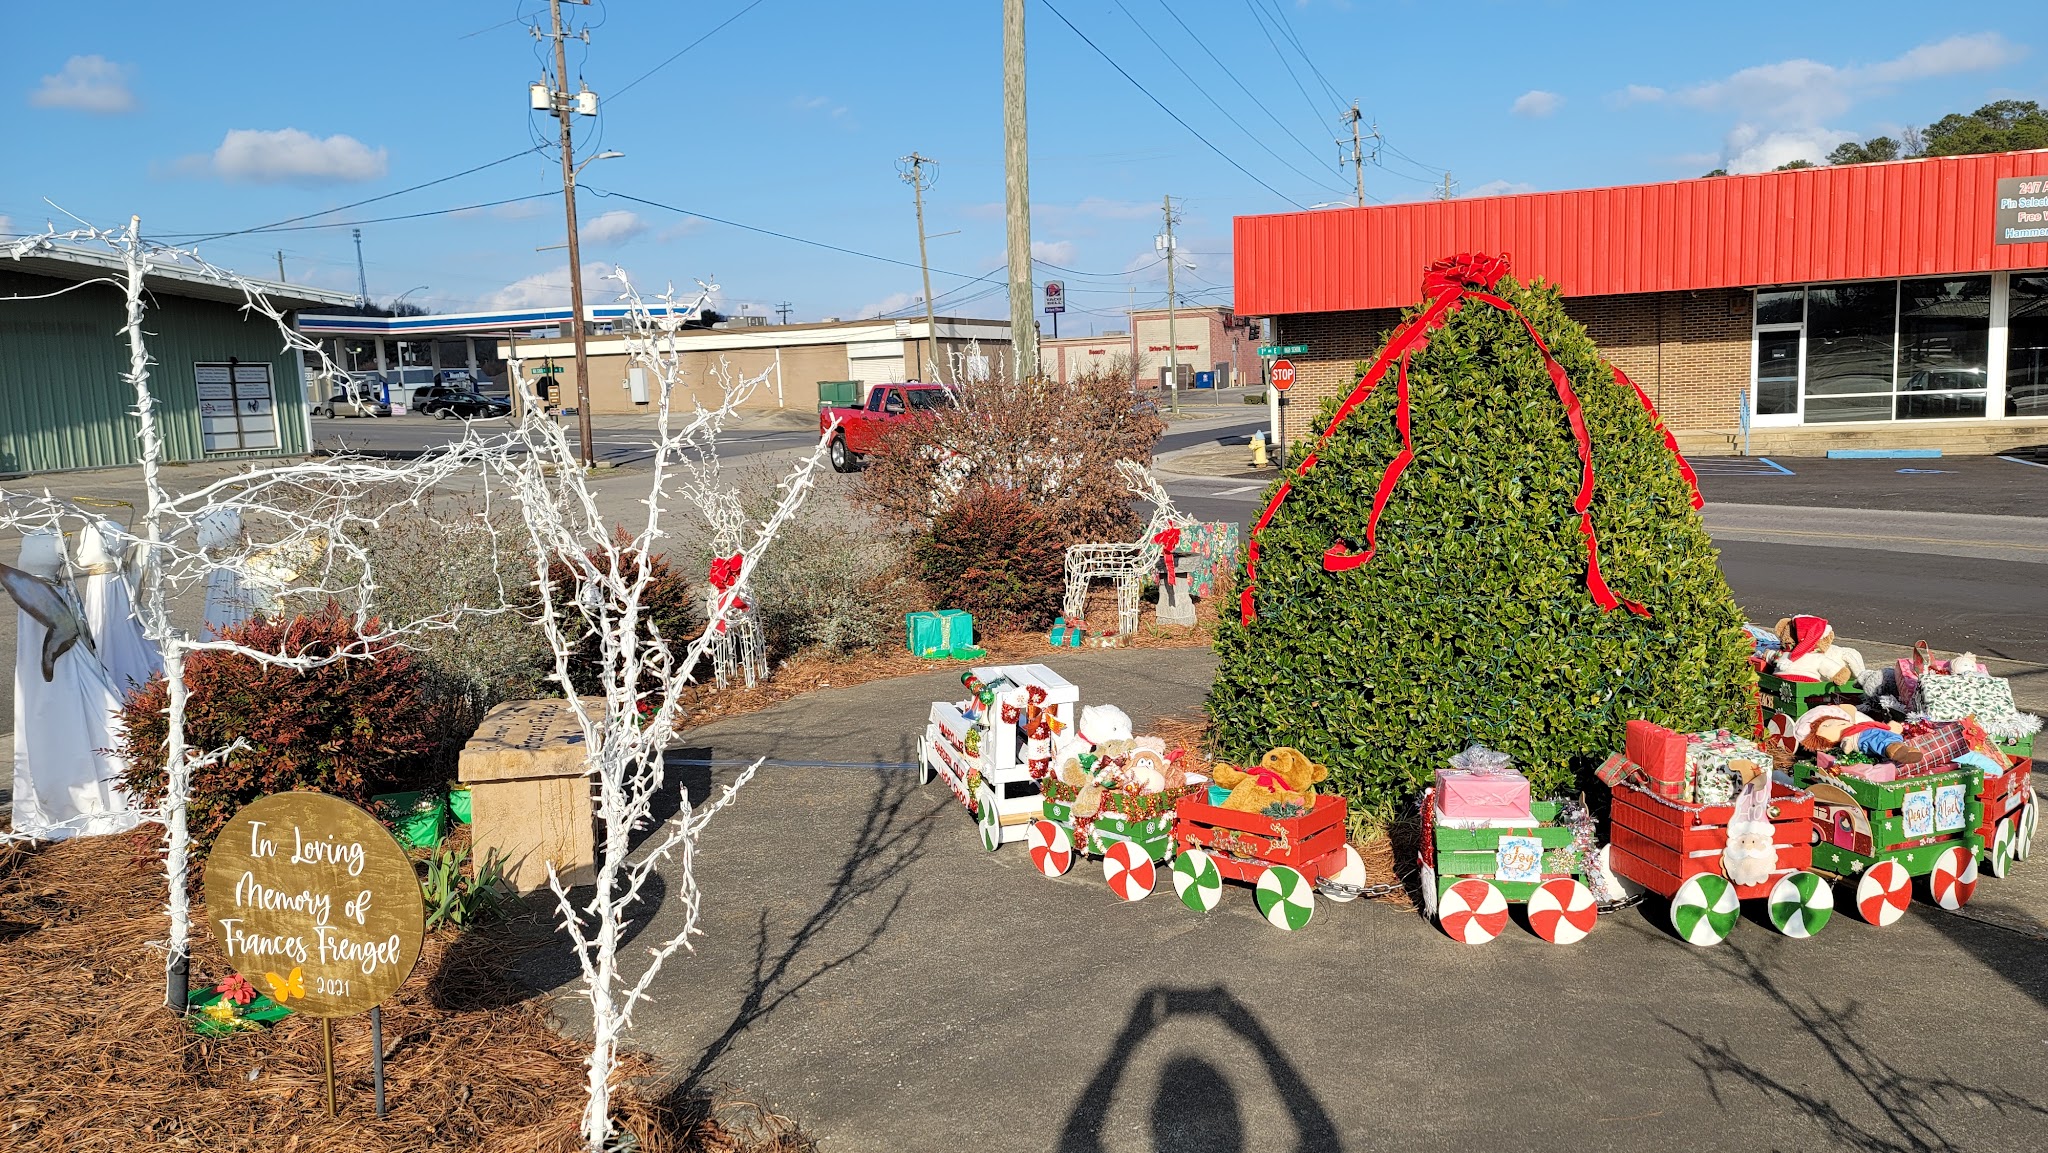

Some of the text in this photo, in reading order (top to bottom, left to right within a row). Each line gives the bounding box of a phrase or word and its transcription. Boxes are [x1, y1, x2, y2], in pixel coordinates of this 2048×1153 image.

[2001, 196, 2048, 209] Pin Select
[2018, 212, 2042, 222] Free
[1272, 368, 1294, 381] STOP
[248, 820, 366, 877] In Loving
[1503, 845, 1535, 871] Joy
[235, 870, 372, 926] Memory of
[219, 918, 401, 975] Frances Frengel
[316, 976, 350, 998] 2021
